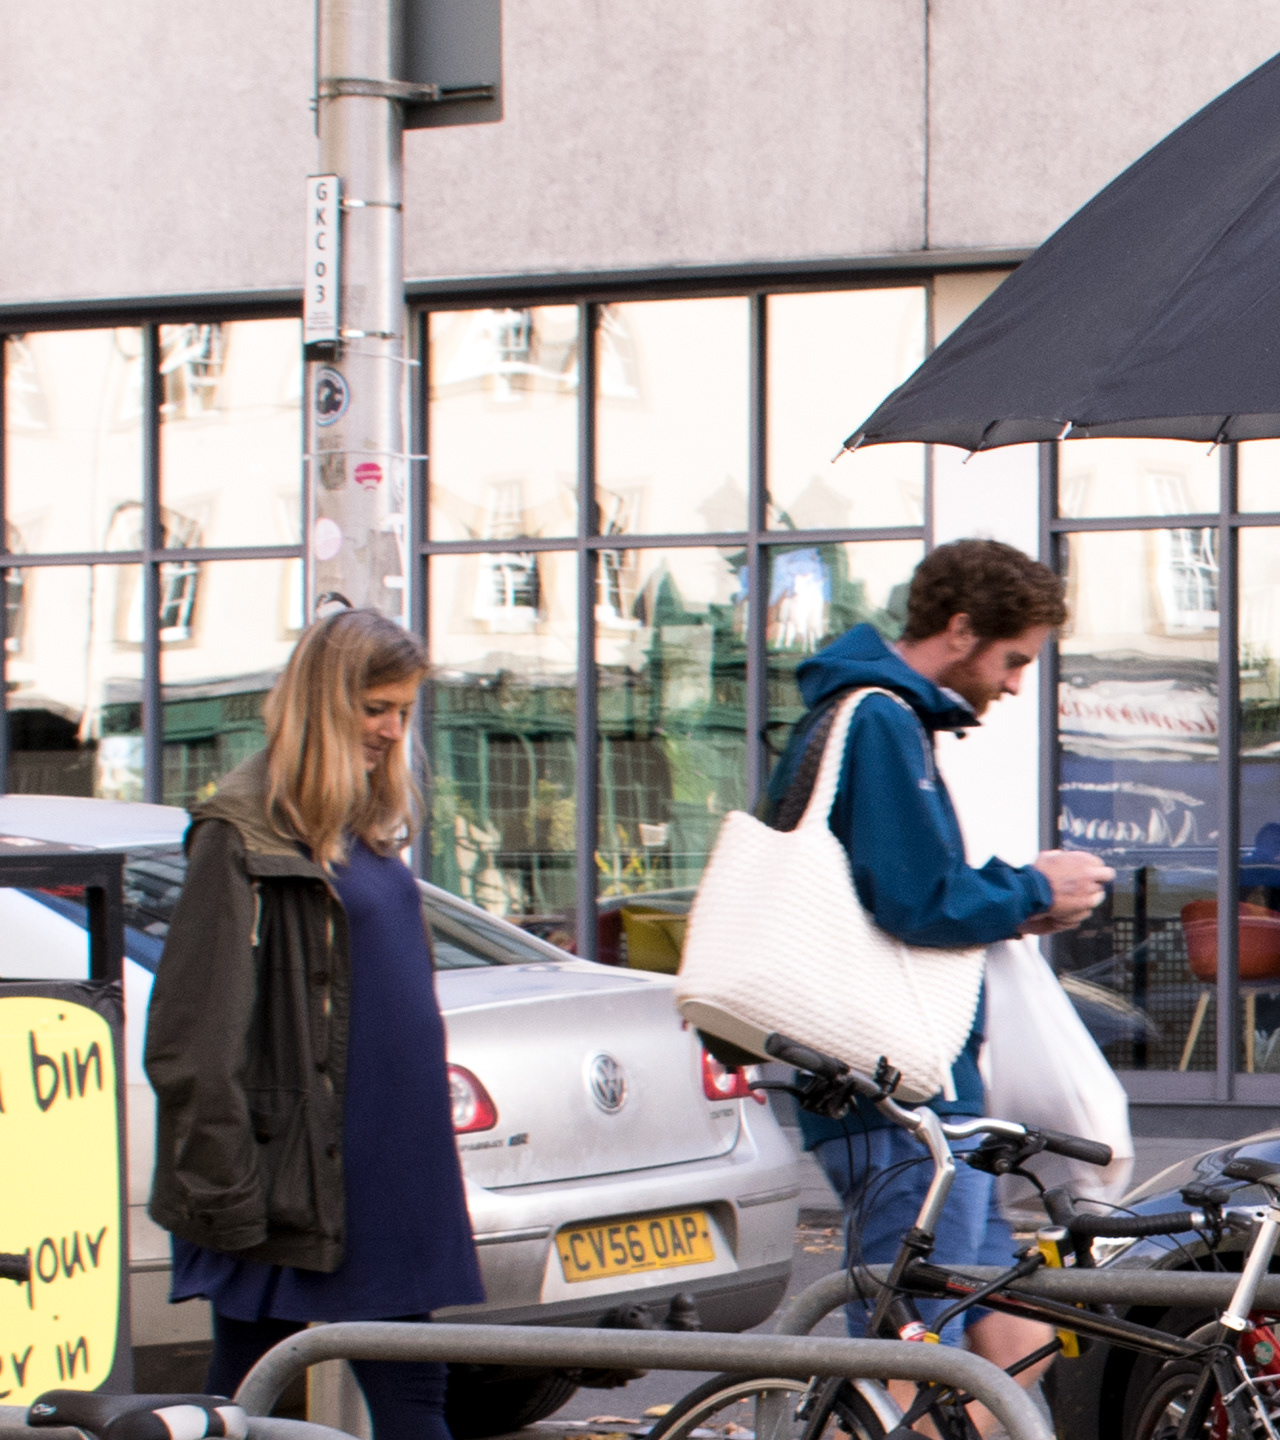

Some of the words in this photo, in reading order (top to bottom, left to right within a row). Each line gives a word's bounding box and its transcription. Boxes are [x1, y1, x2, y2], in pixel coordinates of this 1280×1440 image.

[28, 1013, 102, 1112] bin
[568, 1224, 646, 1272] CV56
[647, 1216, 698, 1260] OAP
